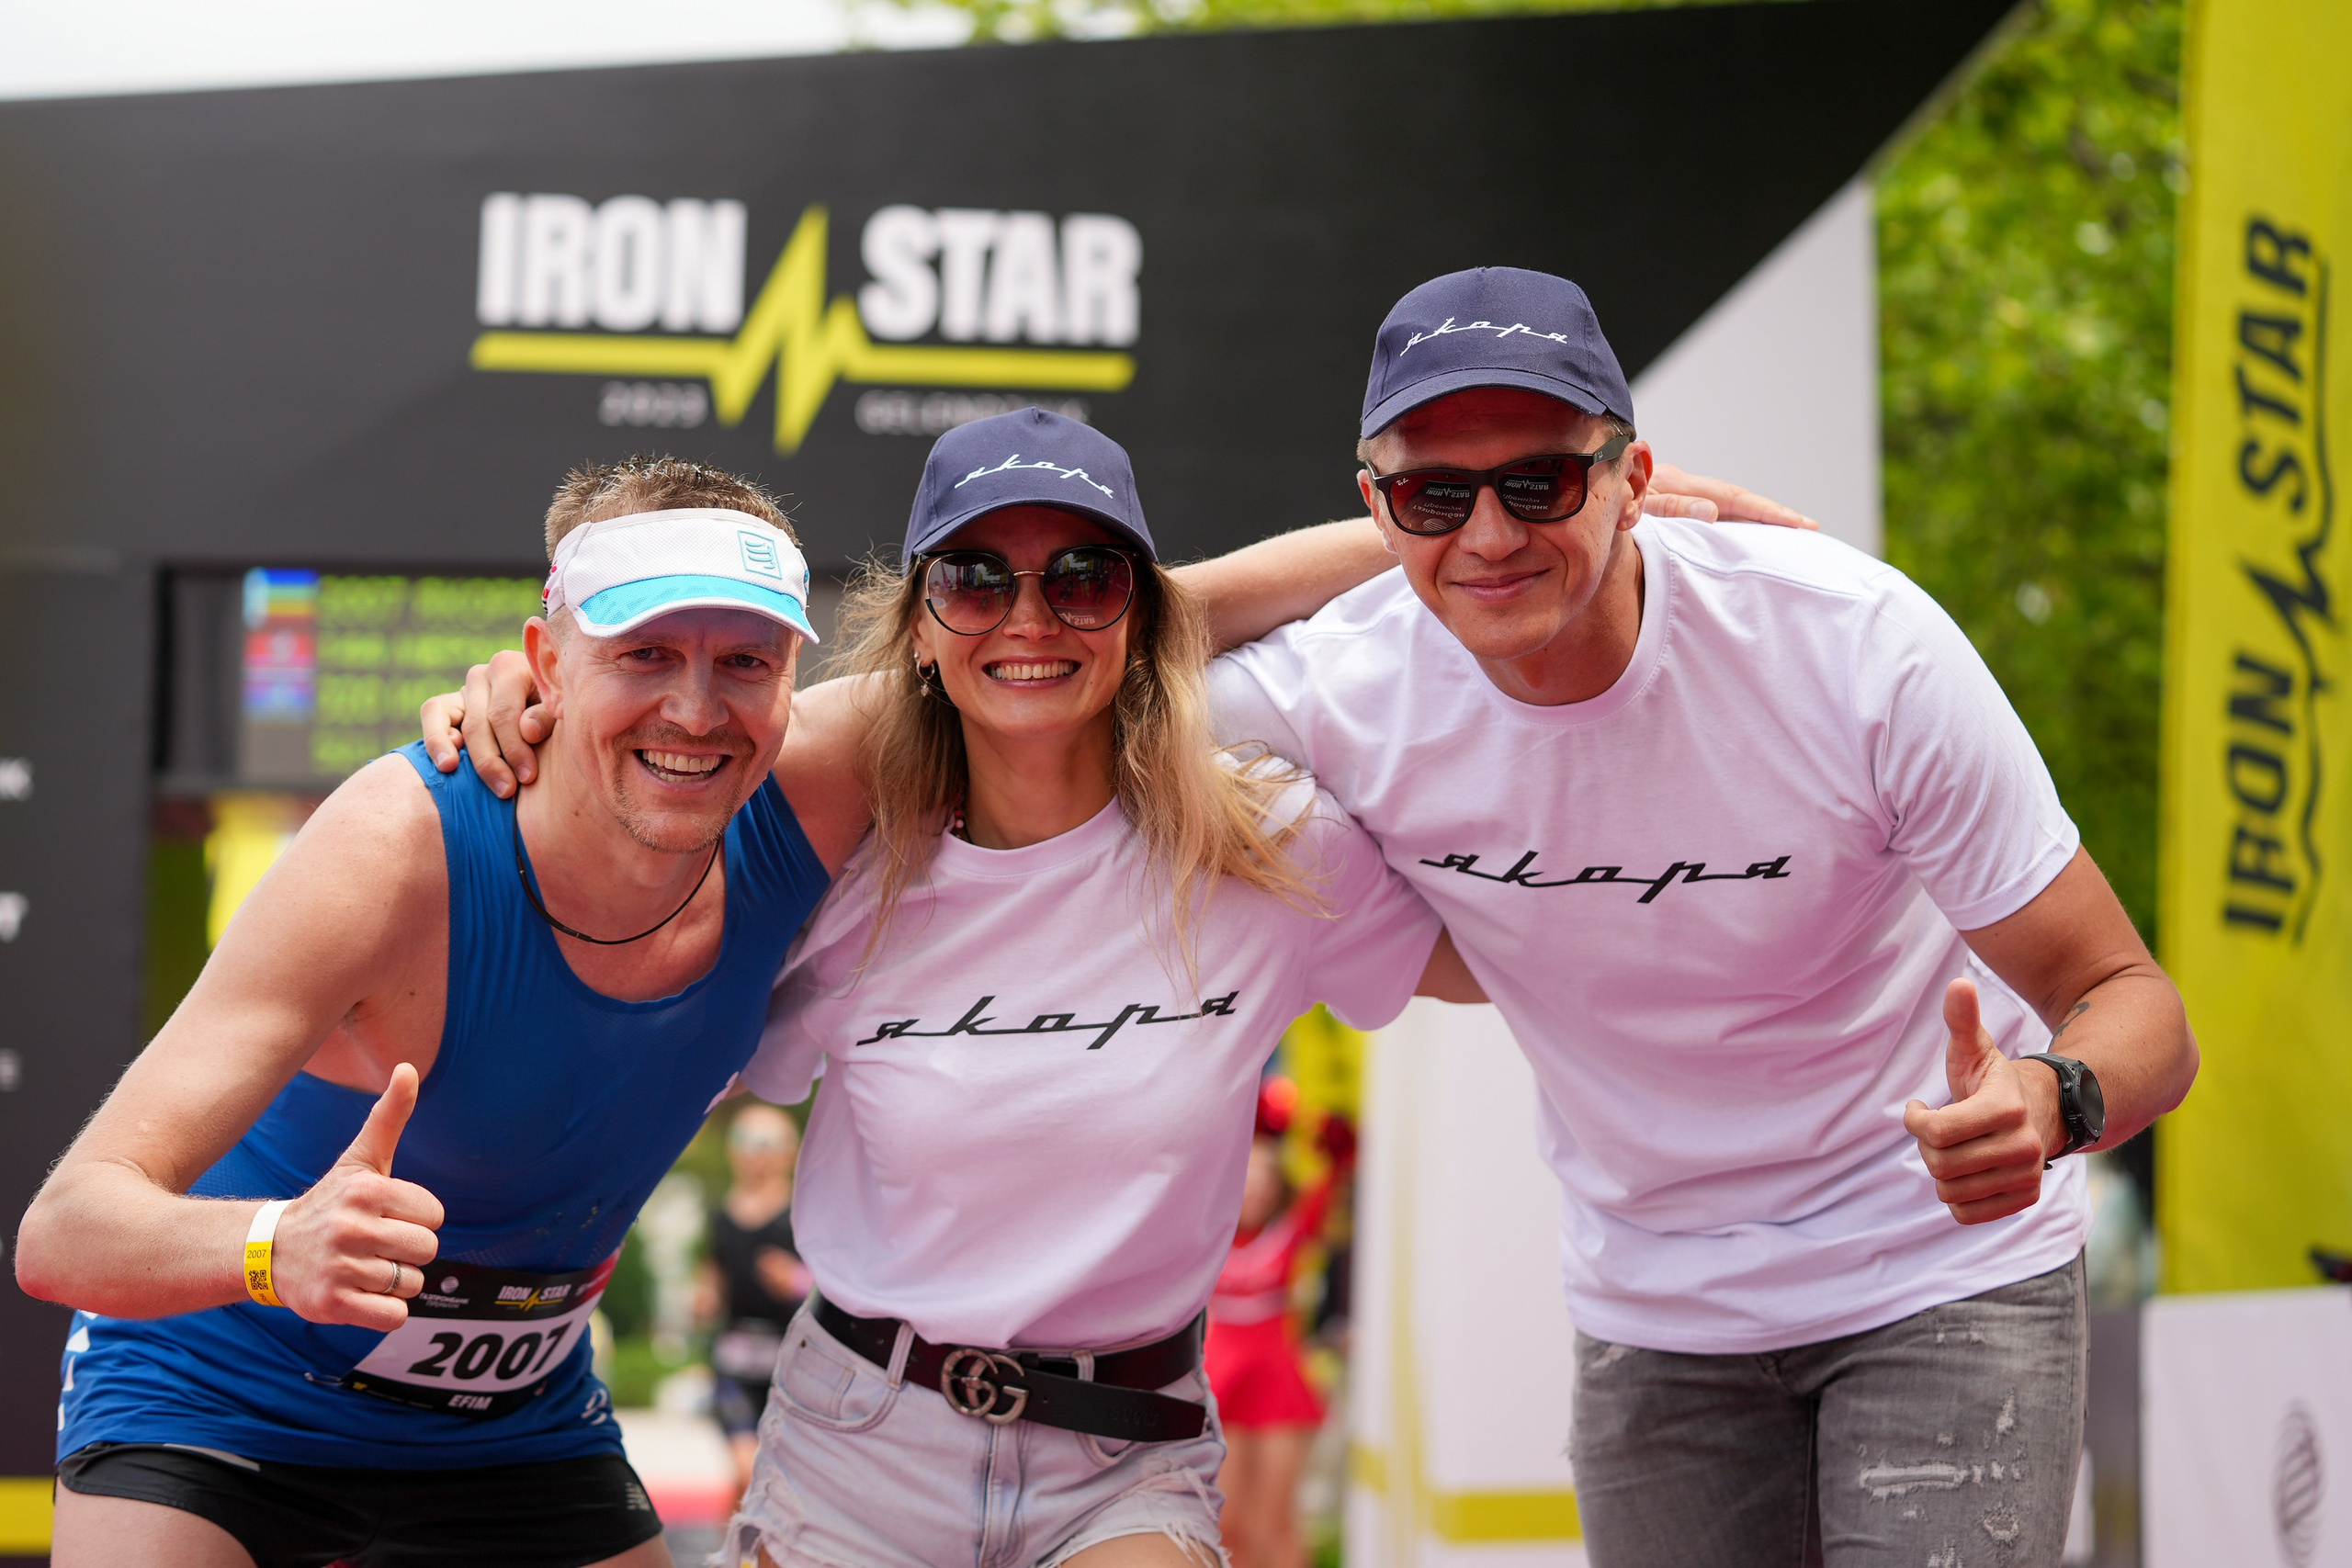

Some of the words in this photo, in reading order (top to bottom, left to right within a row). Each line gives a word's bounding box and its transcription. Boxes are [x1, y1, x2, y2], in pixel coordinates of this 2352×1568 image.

[477, 191, 748, 333] IRON
[858, 203, 1144, 348] STAR
[2234, 217, 2312, 514] STAR
[2223, 650, 2295, 931] IRON
[246, 1249, 267, 1259] 2007
[497, 1285, 533, 1301] IRON
[539, 1284, 572, 1301] STAR
[406, 1320, 573, 1380] 2007
[447, 1394, 493, 1410] EFIM
